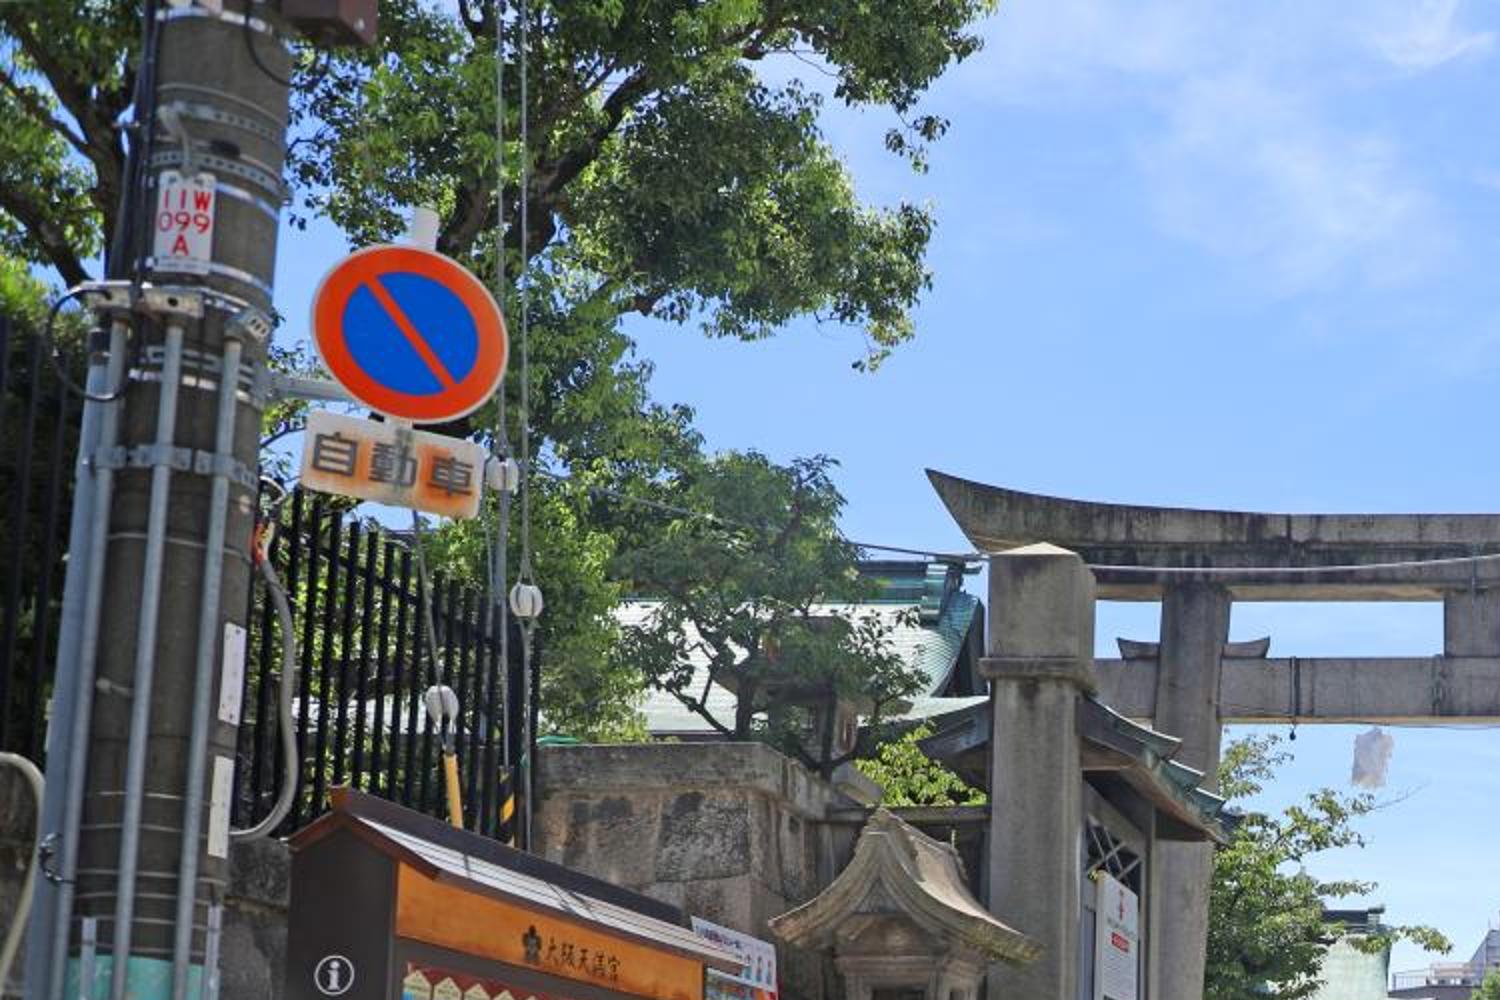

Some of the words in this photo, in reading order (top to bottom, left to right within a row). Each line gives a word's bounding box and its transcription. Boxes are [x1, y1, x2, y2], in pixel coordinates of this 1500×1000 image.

[159, 211, 210, 234] 099
[172, 233, 189, 256] A
[313, 431, 475, 496] 自動車
